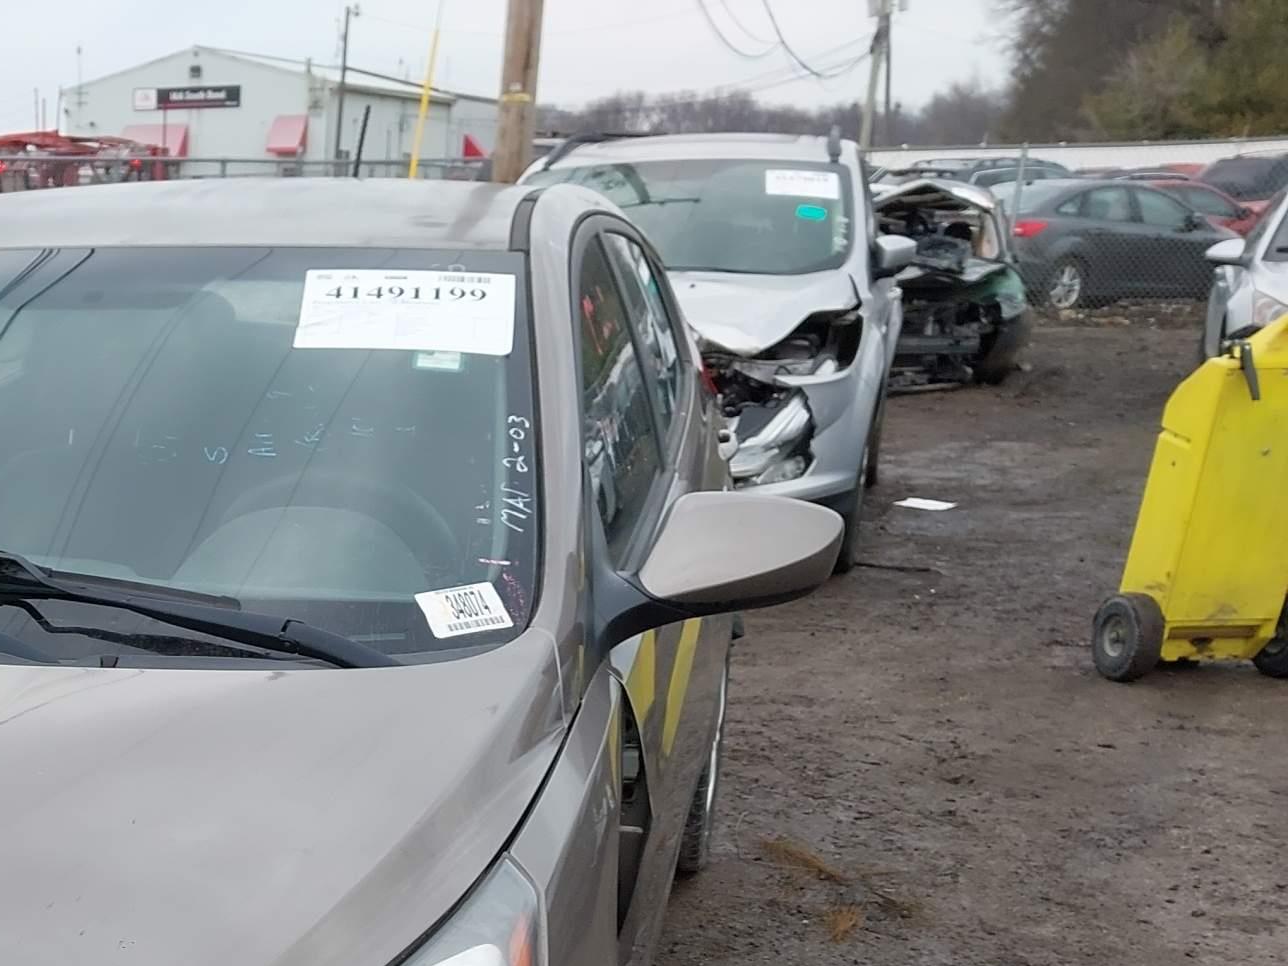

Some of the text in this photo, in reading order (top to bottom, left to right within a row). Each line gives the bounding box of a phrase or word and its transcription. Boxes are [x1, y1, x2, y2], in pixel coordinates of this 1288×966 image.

[325, 285, 488, 301] 41491199
[502, 414, 530, 473] 2-03
[444, 589, 492, 620] 348074
